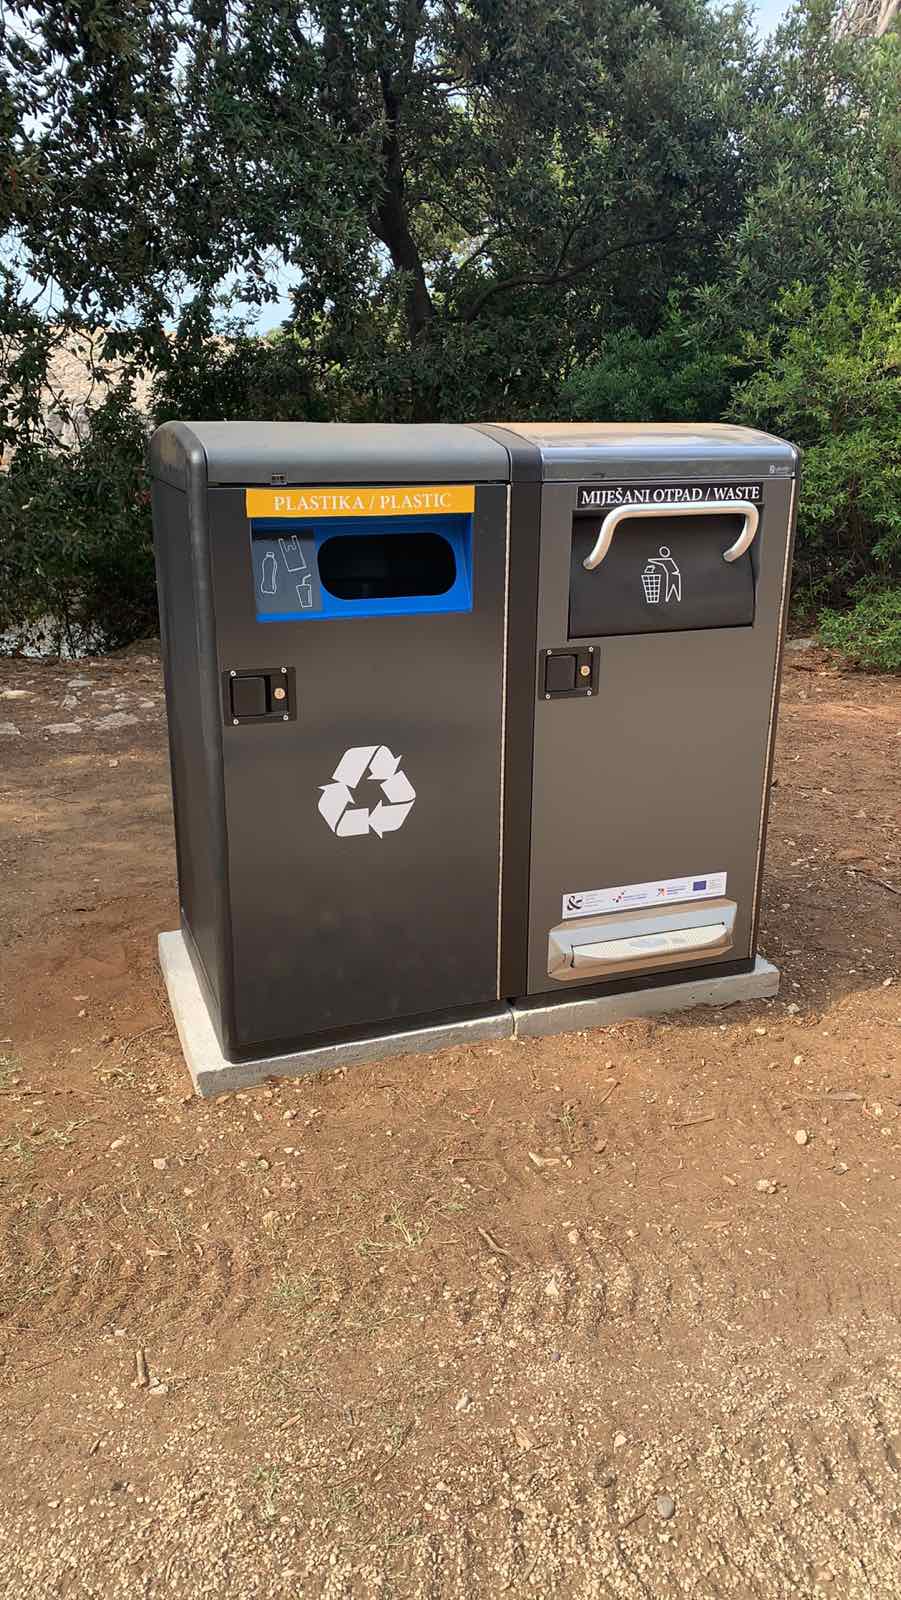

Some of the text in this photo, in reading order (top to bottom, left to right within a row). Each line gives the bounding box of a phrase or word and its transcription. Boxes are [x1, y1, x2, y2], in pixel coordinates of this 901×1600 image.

[274, 495, 365, 511] PLASTIKA
[380, 493, 451, 510] PLASTIC
[581, 488, 650, 506] MIJEŠANI
[653, 487, 701, 502] OTPAD
[713, 486, 760, 501] WASTE
